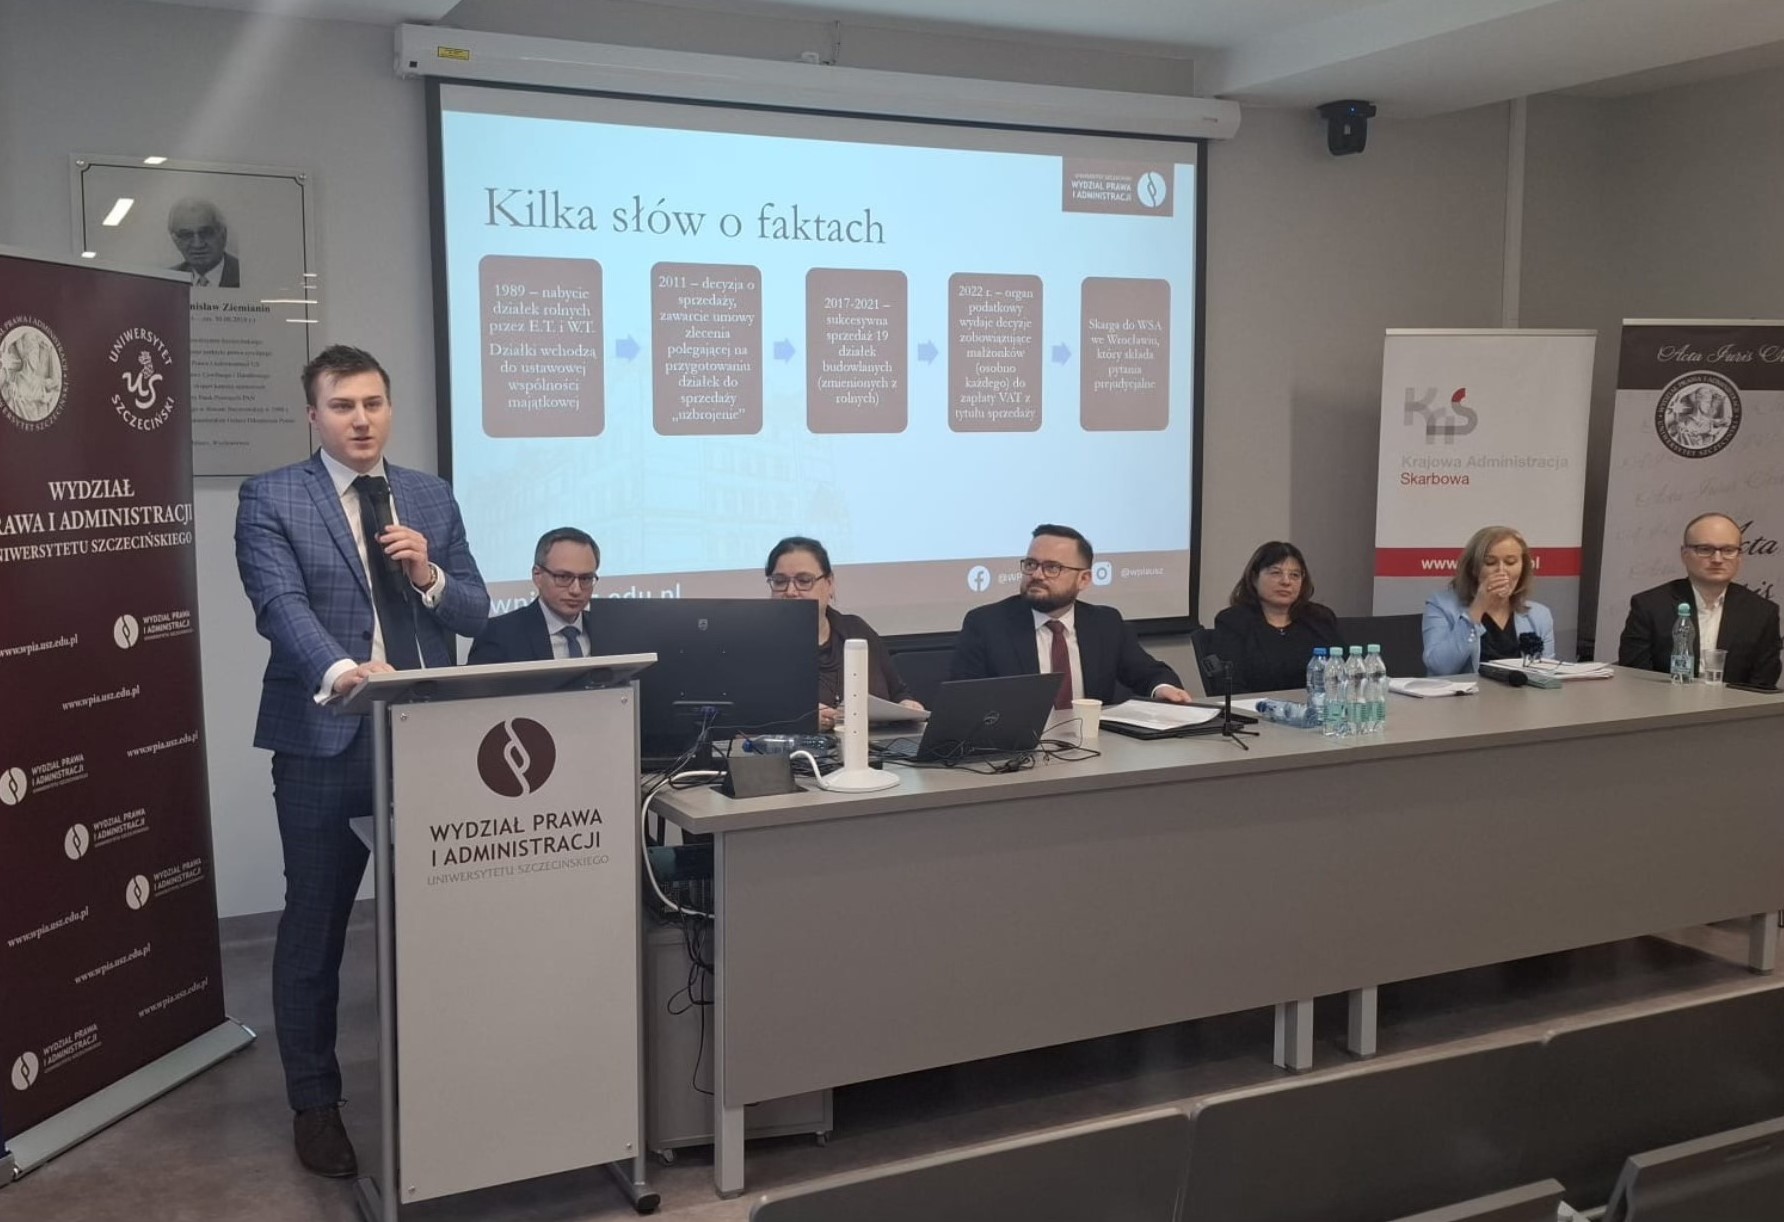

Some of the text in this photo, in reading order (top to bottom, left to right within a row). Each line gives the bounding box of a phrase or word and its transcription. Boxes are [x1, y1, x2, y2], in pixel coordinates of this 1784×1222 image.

[484, 187, 886, 245] Kilka słów o faktach
[658, 276, 686, 288] 2011
[702, 277, 743, 294] decyzja
[495, 284, 525, 297] 1989
[542, 285, 590, 302] nabycie
[959, 286, 983, 297] 2022
[1004, 290, 1033, 301] organ
[190, 302, 270, 312] nisław Ziemianin
[678, 294, 737, 309] sprzedaży,
[824, 297, 879, 310] 2017-2021
[968, 302, 1023, 315] podatkowy
[493, 301, 591, 319] działek rolnych
[660, 310, 755, 326] zawarcie umowy
[826, 314, 888, 329] sukcesywna
[959, 317, 993, 331] wydaje
[1089, 318, 1162, 333] Skarga do WSA
[489, 322, 525, 335] przez
[529, 320, 557, 332] E.T.
[568, 321, 596, 333] W.T.
[685, 326, 730, 338] zlecenia
[826, 329, 889, 344] sprzedaż 19
[108, 327, 173, 366] UNIWERSYTET
[489, 344, 597, 359] Działki wchodzą
[667, 343, 747, 358] polegającej na
[838, 344, 877, 357] działek
[1657, 344, 1703, 362] Acta
[500, 360, 586, 376] do ustawowej
[665, 360, 750, 375] przygotowaniu
[823, 360, 892, 375] budowlanych
[508, 378, 579, 394] wspólności
[678, 376, 738, 387] działek do
[892, 379, 897, 388] z
[1012, 377, 1026, 388] do
[508, 396, 580, 410] majątkowej
[680, 391, 737, 407] sprzedaży
[836, 392, 880, 408] rolnych)
[999, 392, 1022, 403] VAT
[111, 393, 175, 431] SZCZECIŃSKI
[955, 407, 984, 421] tytułu
[1401, 455, 1569, 470] Krajowa Administracja
[1400, 472, 1470, 486] Skarbowa
[48, 479, 135, 501] WYDZIAŁ
[49, 512, 55, 531] I
[59, 503, 193, 531] ADMINISTRACJI
[91, 531, 192, 553] SZCZECIŃSKIEGO
[62, 685, 140, 711] www.wpia.usz.edu.pl
[127, 730, 199, 758] www.wpia.usz.edu.pl
[430, 809, 603, 842] WYDZIAŁ PRAWA
[432, 831, 600, 867] I ADMINISTRACJI
[427, 867, 514, 886] UNIWERSYTETU
[7, 905, 89, 948] www.wpia.usz.edu.pl
[74, 942, 151, 984] www.wpia.usz.edu.pl
[138, 977, 208, 1018] www.wpia.usz.edu.pl
